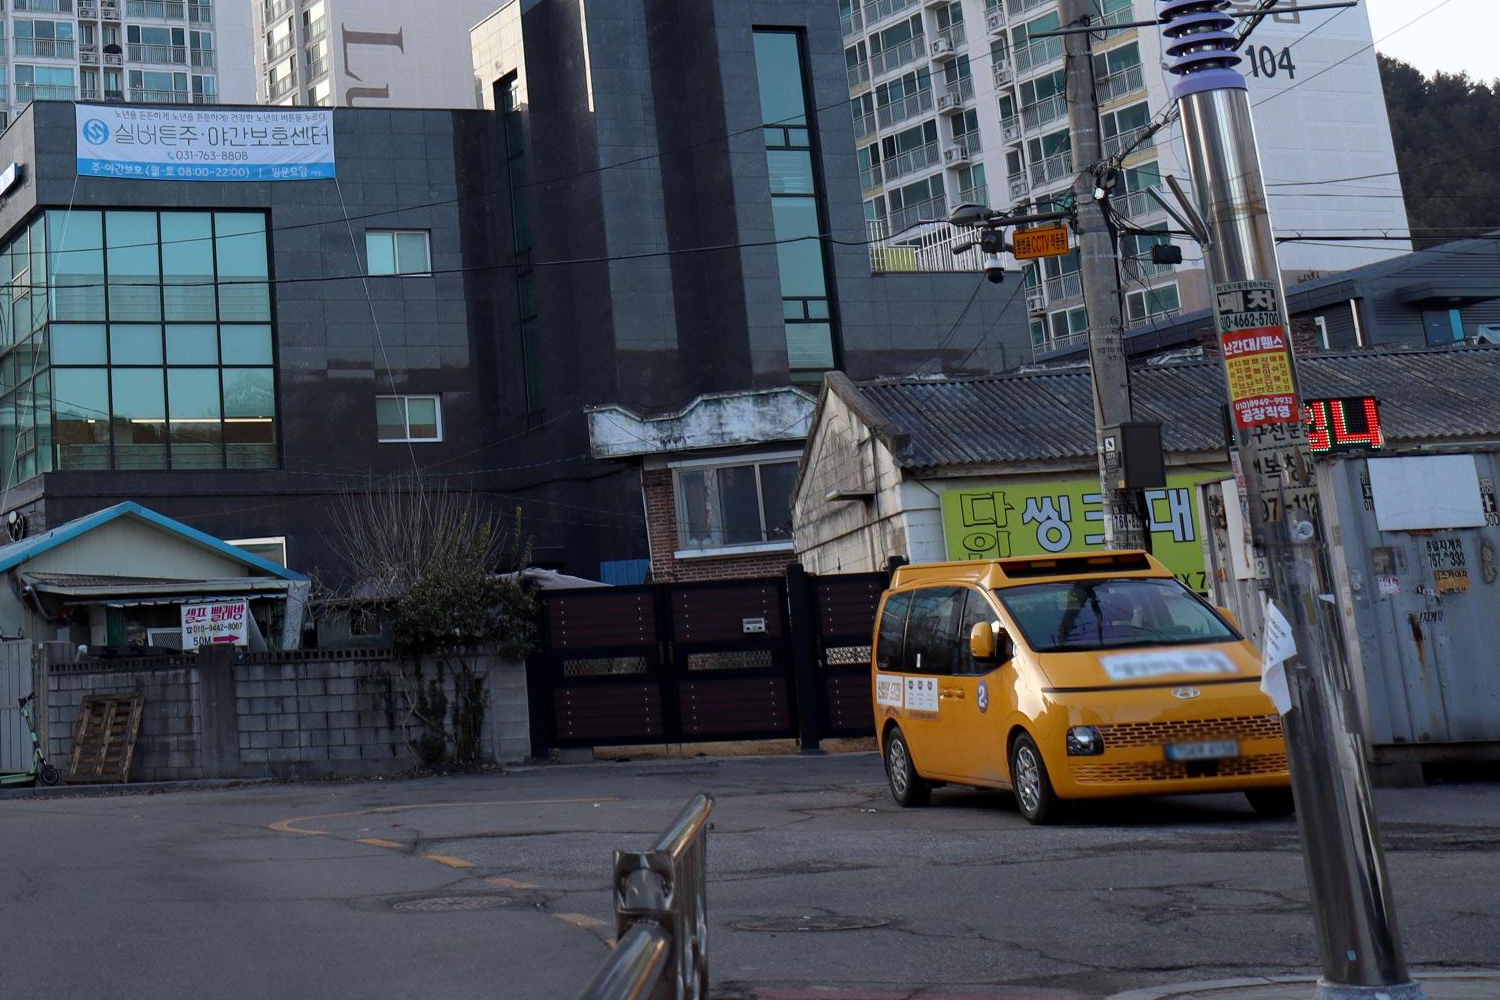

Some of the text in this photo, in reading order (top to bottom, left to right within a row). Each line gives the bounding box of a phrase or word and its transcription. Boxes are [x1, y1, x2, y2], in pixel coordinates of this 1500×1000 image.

[1245, 45, 1296, 79] 104
[175, 150, 249, 161] 031-763-8808
[1032, 235, 1049, 252] CCTV
[185, 604, 244, 624] 셀프 빨래방
